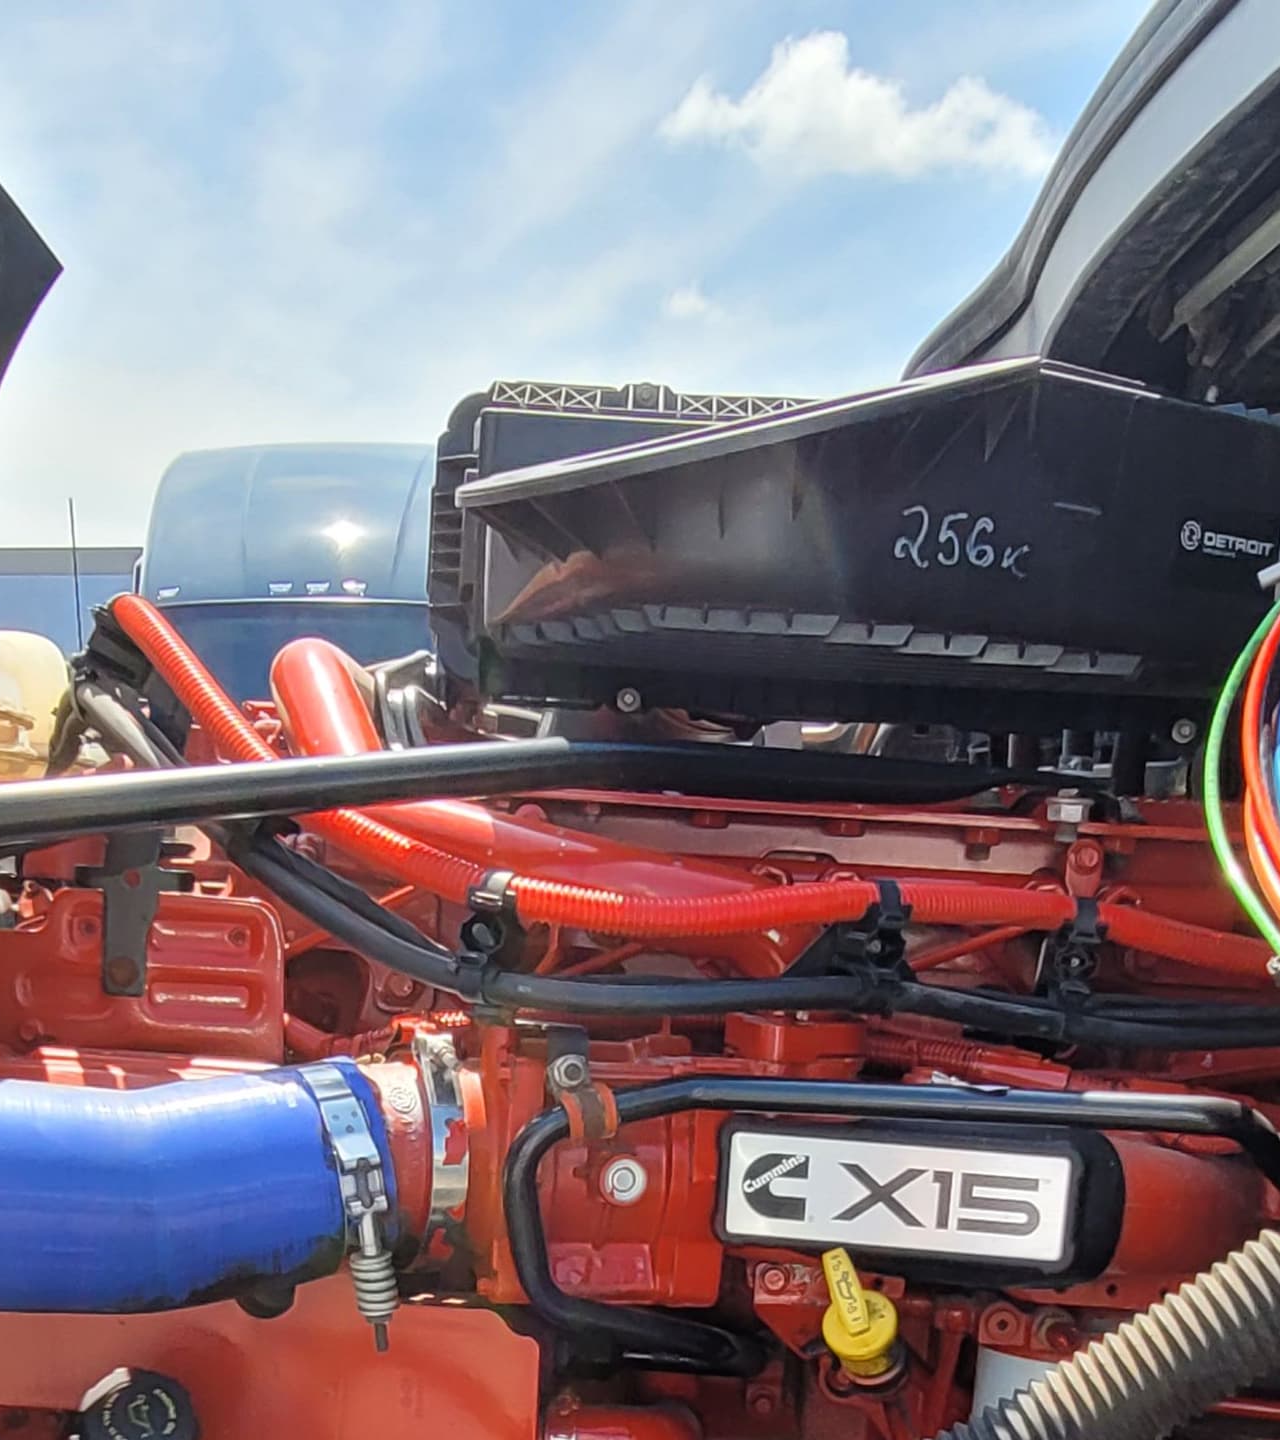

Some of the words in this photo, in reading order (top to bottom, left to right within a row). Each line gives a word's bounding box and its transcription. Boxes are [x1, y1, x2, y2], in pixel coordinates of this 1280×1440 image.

[1203, 531, 1274, 557] DETROIT
[742, 1154, 807, 1194] Cummins
[831, 1162, 1040, 1237] X15
